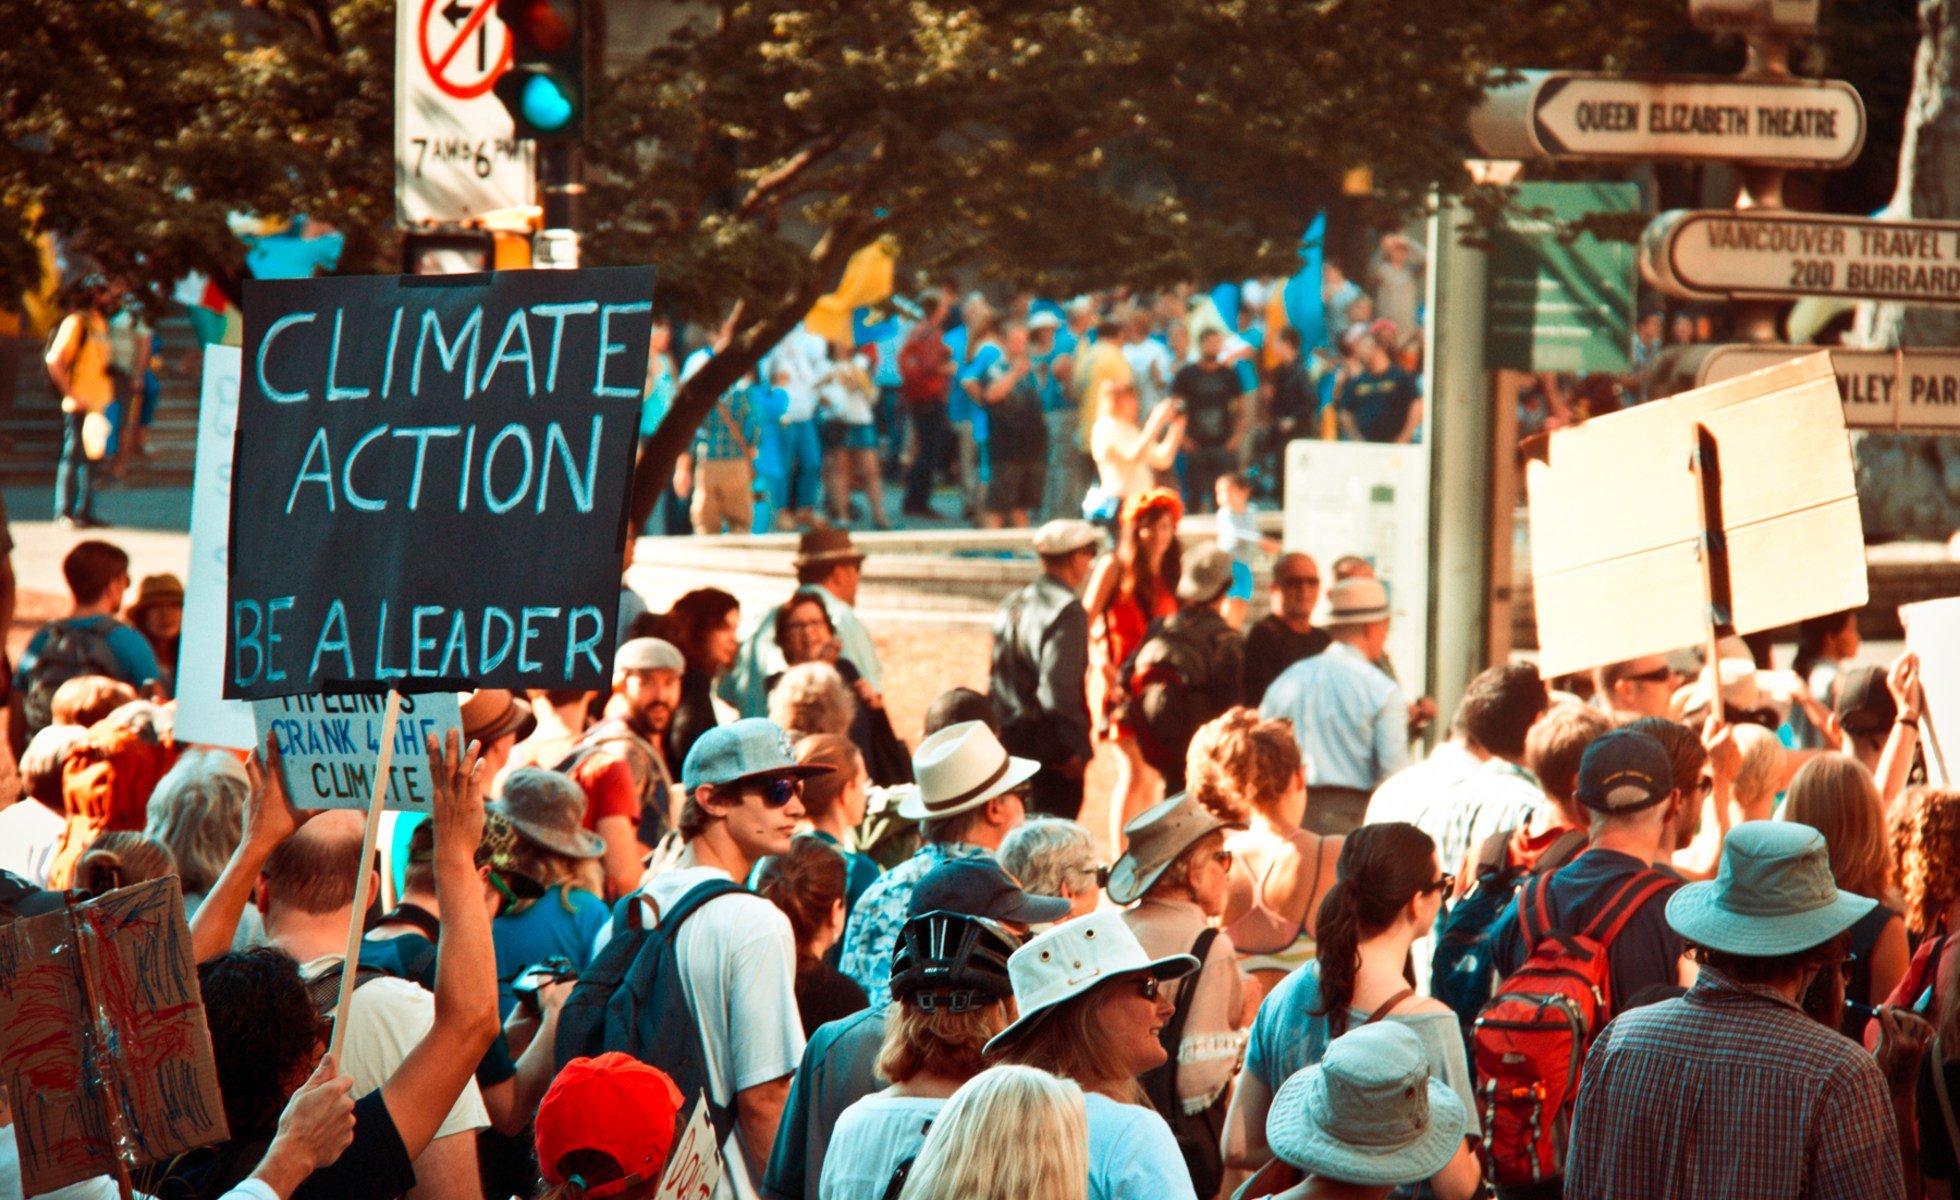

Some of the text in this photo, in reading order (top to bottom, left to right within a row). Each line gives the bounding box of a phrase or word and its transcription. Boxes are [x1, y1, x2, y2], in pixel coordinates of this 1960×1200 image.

[1576, 101, 1838, 139] QUEEN ELIZABETH THEATRE
[1706, 222, 1846, 256] VANCOUVER
[1859, 227, 1943, 261] TRAVEL
[1789, 259, 1960, 293] 200 BURRARD
[257, 301, 652, 402] CLIMATE
[286, 414, 603, 514] ACTION
[233, 596, 604, 687] BE A LEADER
[271, 719, 358, 756] CRANK
[312, 762, 425, 802] CLIMTE
